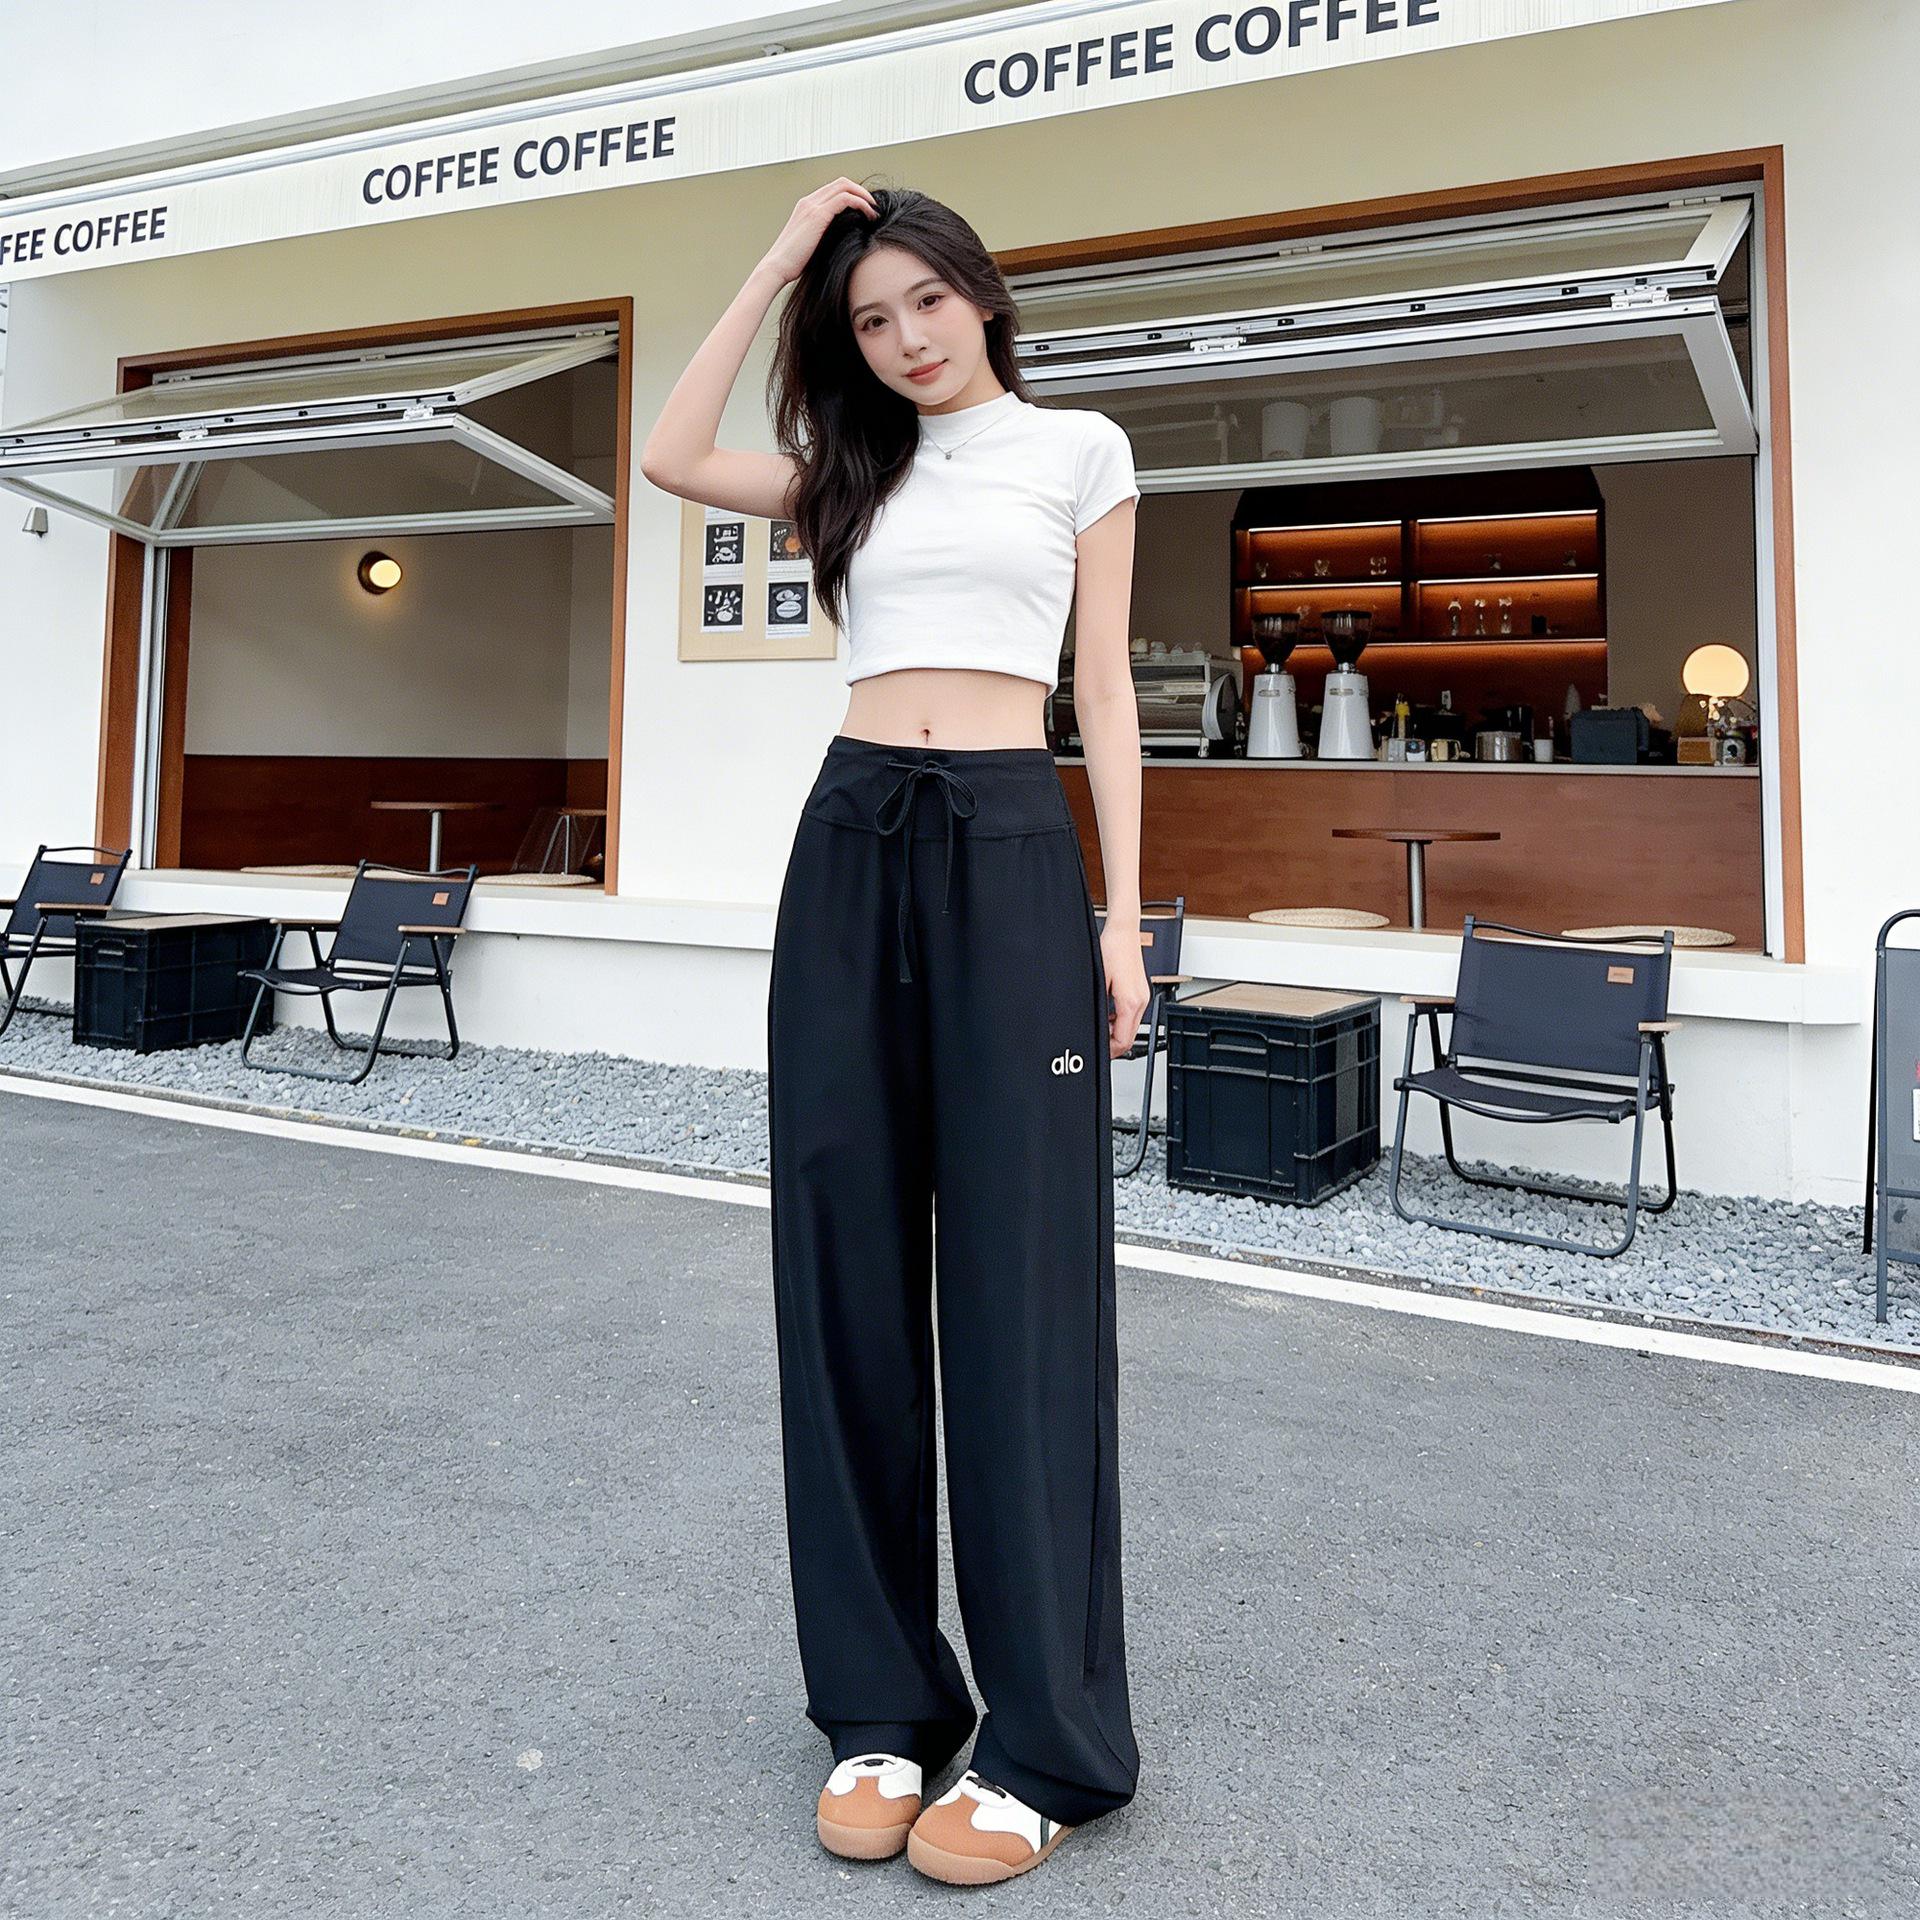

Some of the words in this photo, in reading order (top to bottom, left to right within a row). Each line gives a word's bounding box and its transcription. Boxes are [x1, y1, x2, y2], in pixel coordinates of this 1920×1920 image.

[964, 23, 1174, 105] COFFEE
[362, 146, 500, 205] COFFEE
[513, 116, 676, 179] COFFEE
[53, 206, 168, 256] COFFEE
[1051, 1048, 1084, 1075] alo
